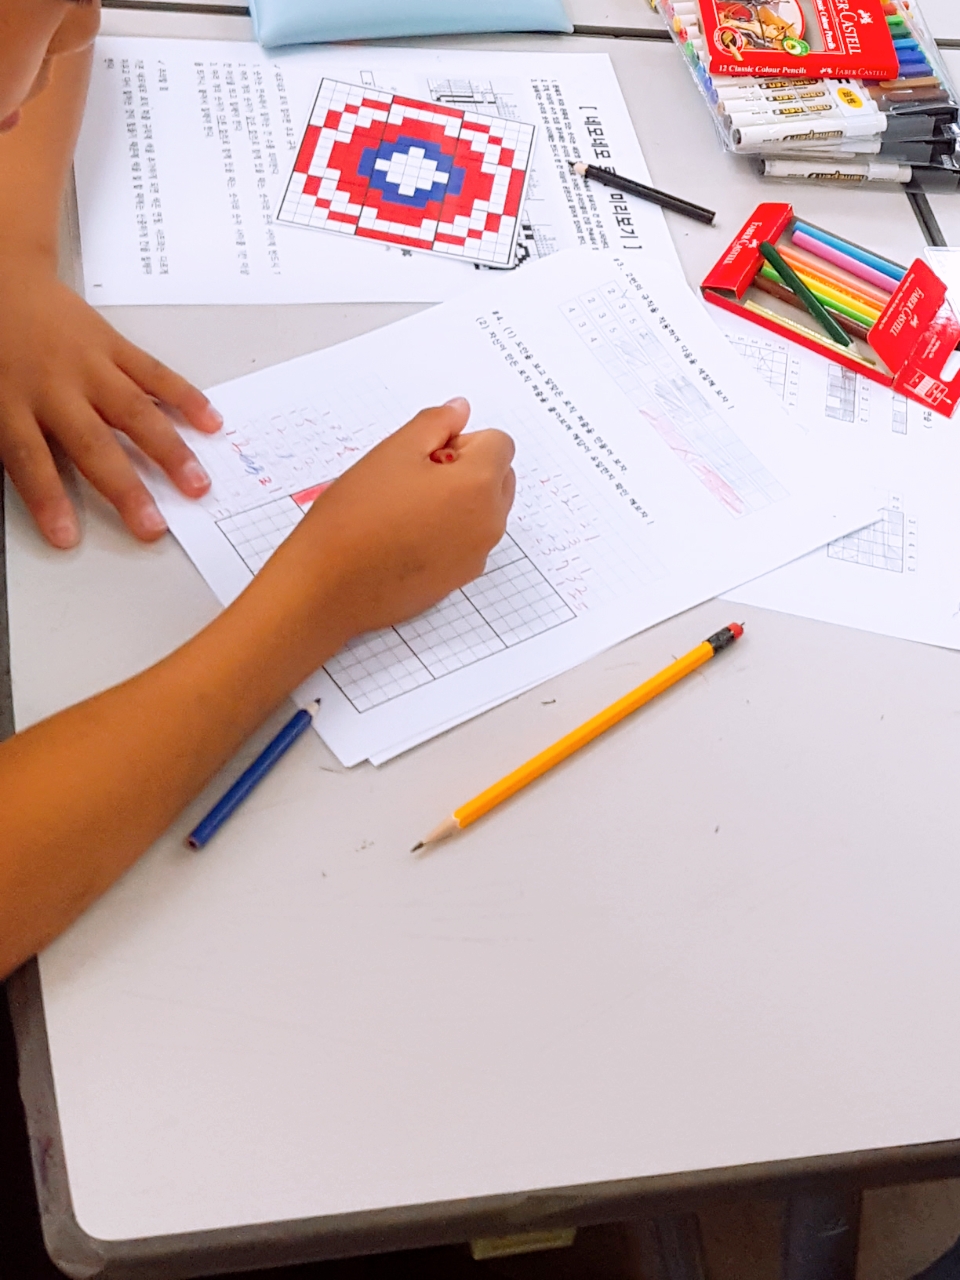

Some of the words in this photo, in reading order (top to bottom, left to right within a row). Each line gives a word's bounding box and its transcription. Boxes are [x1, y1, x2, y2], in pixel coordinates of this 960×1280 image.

[728, 65, 753, 73] Classic
[755, 65, 780, 73] Colour
[783, 66, 807, 74] Pencils
[585, 116, 610, 158] 네모네모
[610, 192, 637, 238] 미리보기
[503, 327, 517, 339] (1)
[516, 342, 533, 360] 도안을
[532, 363, 546, 376] 보고
[545, 378, 563, 397] 알맞은
[563, 400, 577, 413] 로직
[578, 416, 594, 434] 퍼즐을
[594, 436, 613, 455] 만들어
[626, 273, 642, 291] 2번의
[642, 295, 658, 313] 규칙을
[660, 317, 680, 342] 적용하여
[682, 345, 697, 364] 다음을
[699, 368, 715, 387] 색칠해
[715, 390, 728, 402] 보자
[476, 317, 489, 329] (2)
[489, 331, 507, 351] 자신이
[505, 353, 519, 366] 만든
[518, 370, 531, 382] 로직
[532, 385, 548, 403] 퍼즐을
[615, 483, 628, 496] 확인
